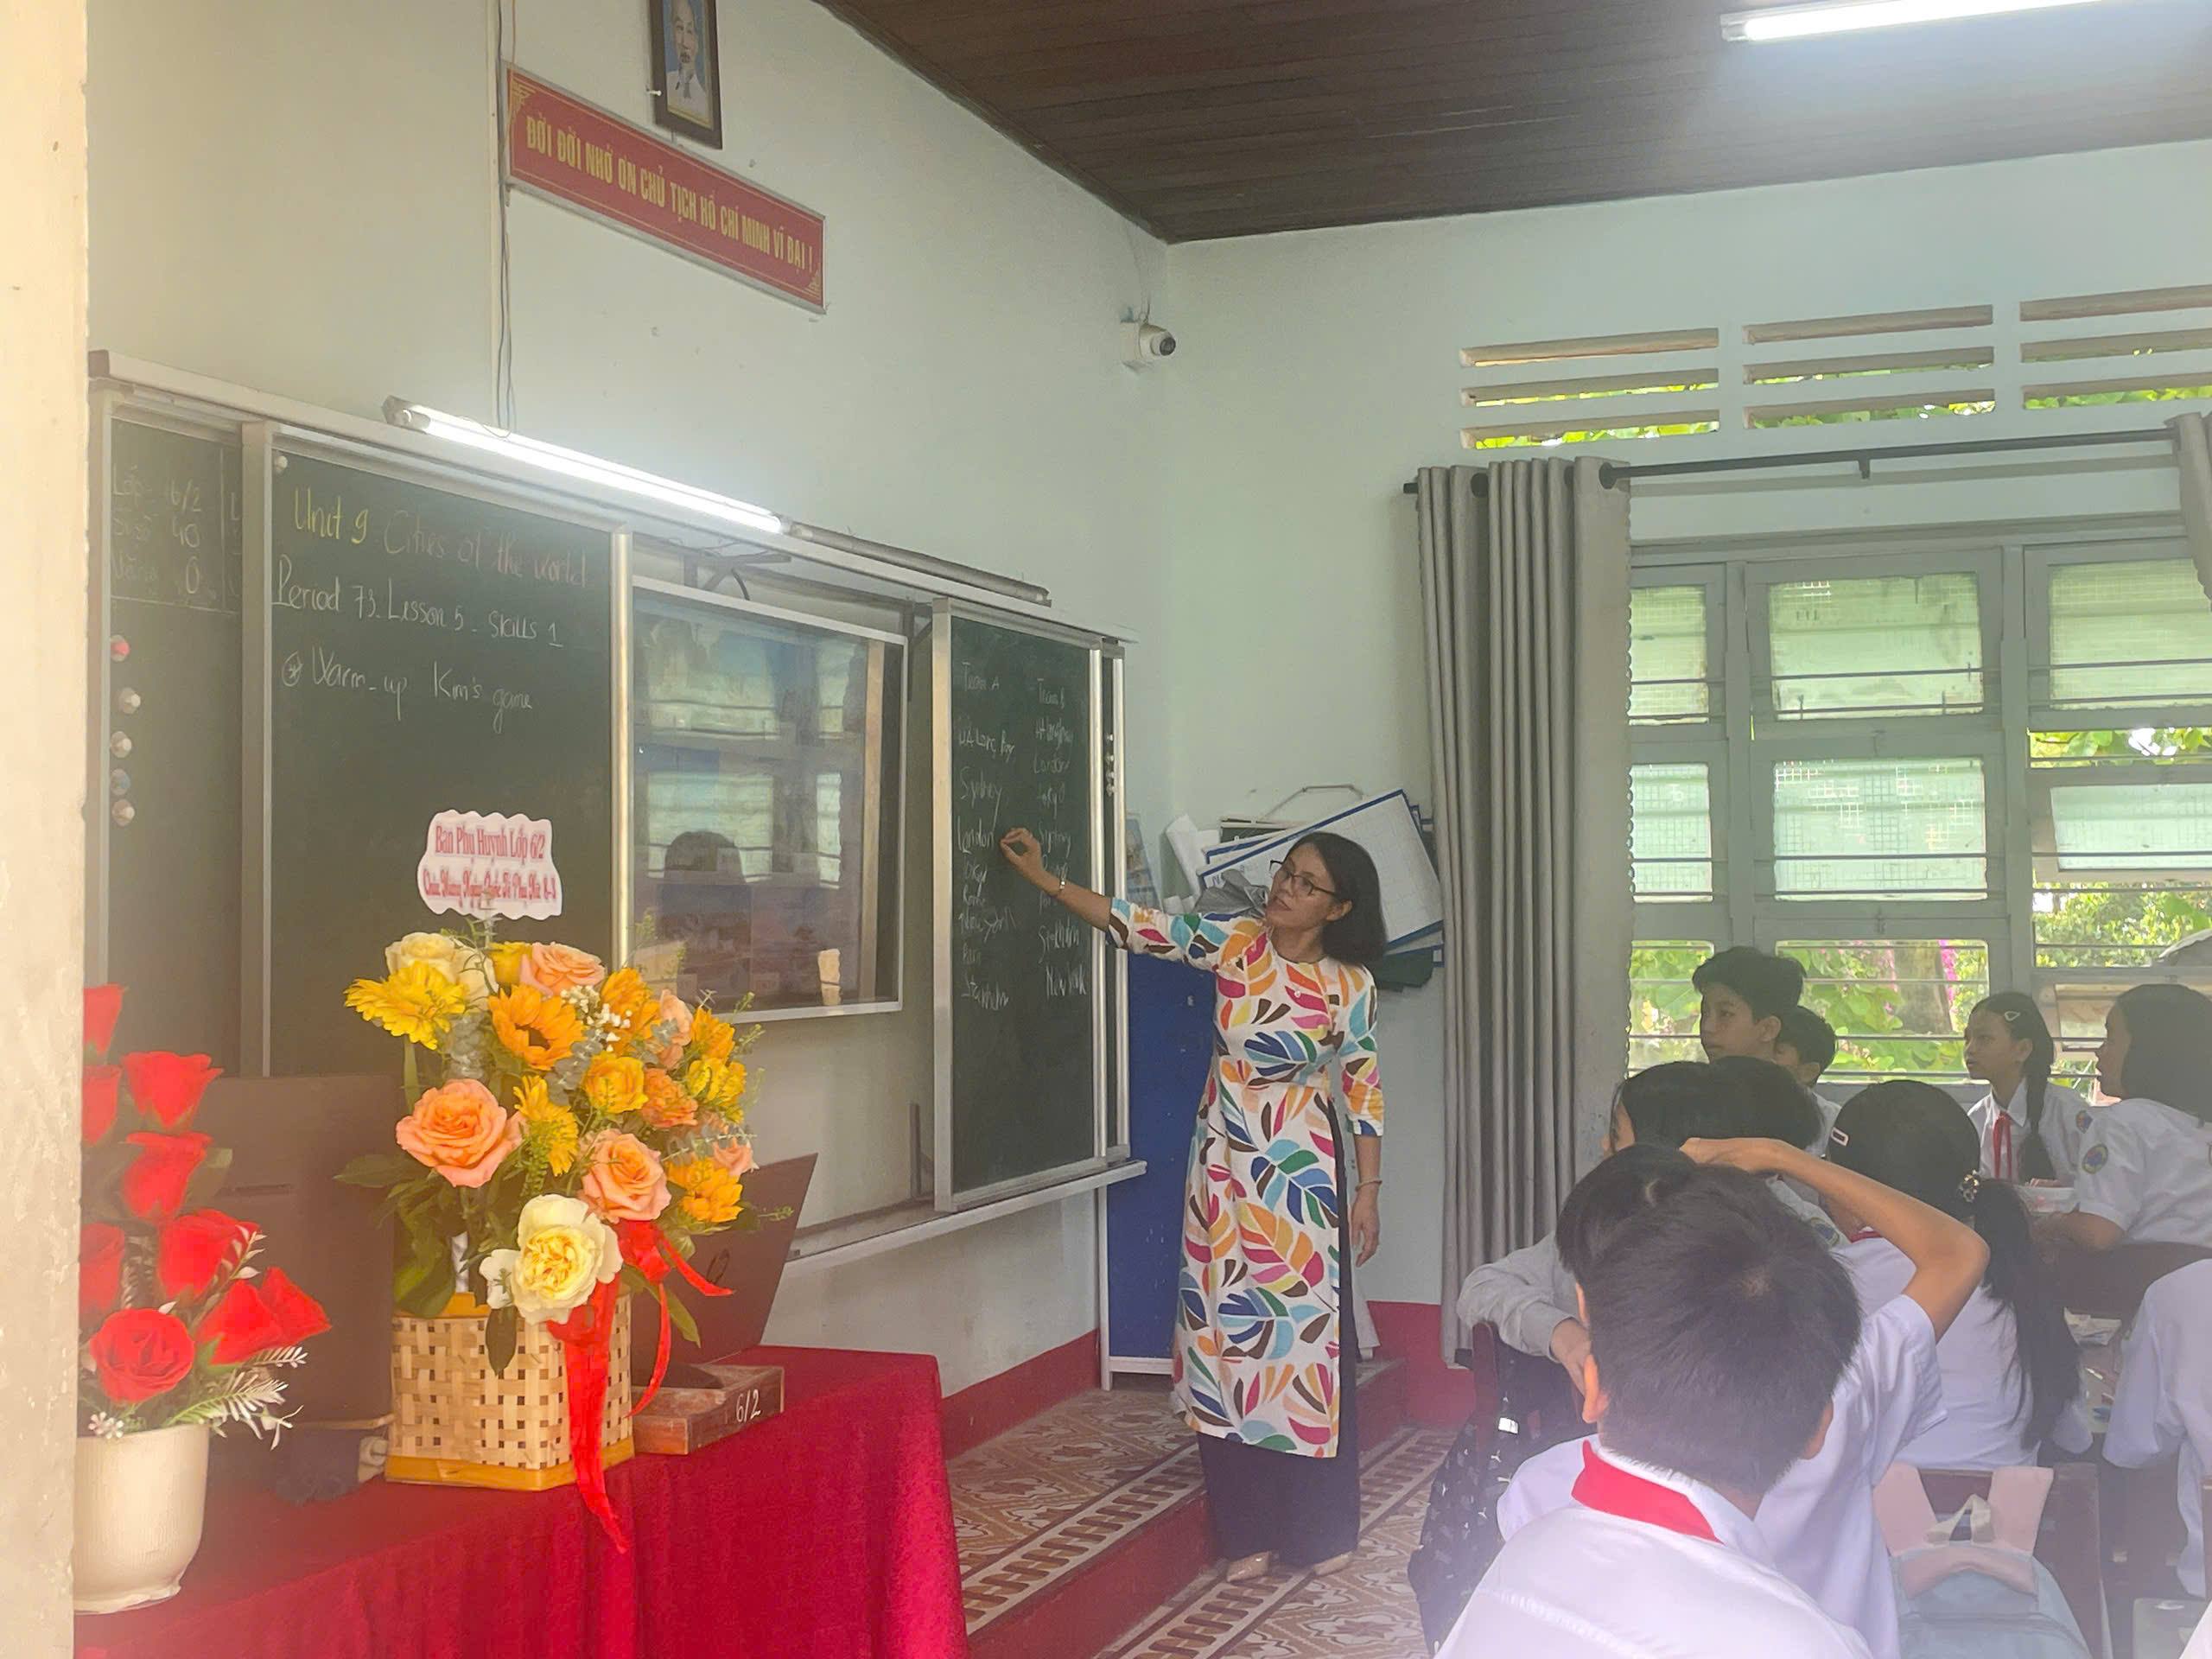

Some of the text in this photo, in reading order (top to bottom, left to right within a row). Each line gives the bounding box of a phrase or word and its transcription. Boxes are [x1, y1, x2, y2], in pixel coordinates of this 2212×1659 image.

[526, 112, 551, 157] ĐỜI
[556, 126, 581, 170] ĐỜI
[618, 156, 637, 194] ƠN
[640, 166, 665, 208] CHỦ
[670, 182, 696, 223] TỊCH
[700, 193, 716, 230] HỒ
[721, 205, 739, 240] CHÍ
[742, 215, 770, 254] MINH
[787, 238, 805, 275] ĐẠI
[295, 486, 588, 588] Unit 9 Cities of the world
[270, 553, 341, 612] Period
[388, 578, 448, 629] Lesson
[453, 605, 464, 632] 5
[489, 610, 537, 640] Skills
[548, 622, 563, 647] 1
[433, 661, 482, 701] Kim's
[493, 688, 533, 734] game
[435, 825, 454, 854] Ban
[957, 816, 995, 855] London
[736, 1389, 761, 1423] 6/2
